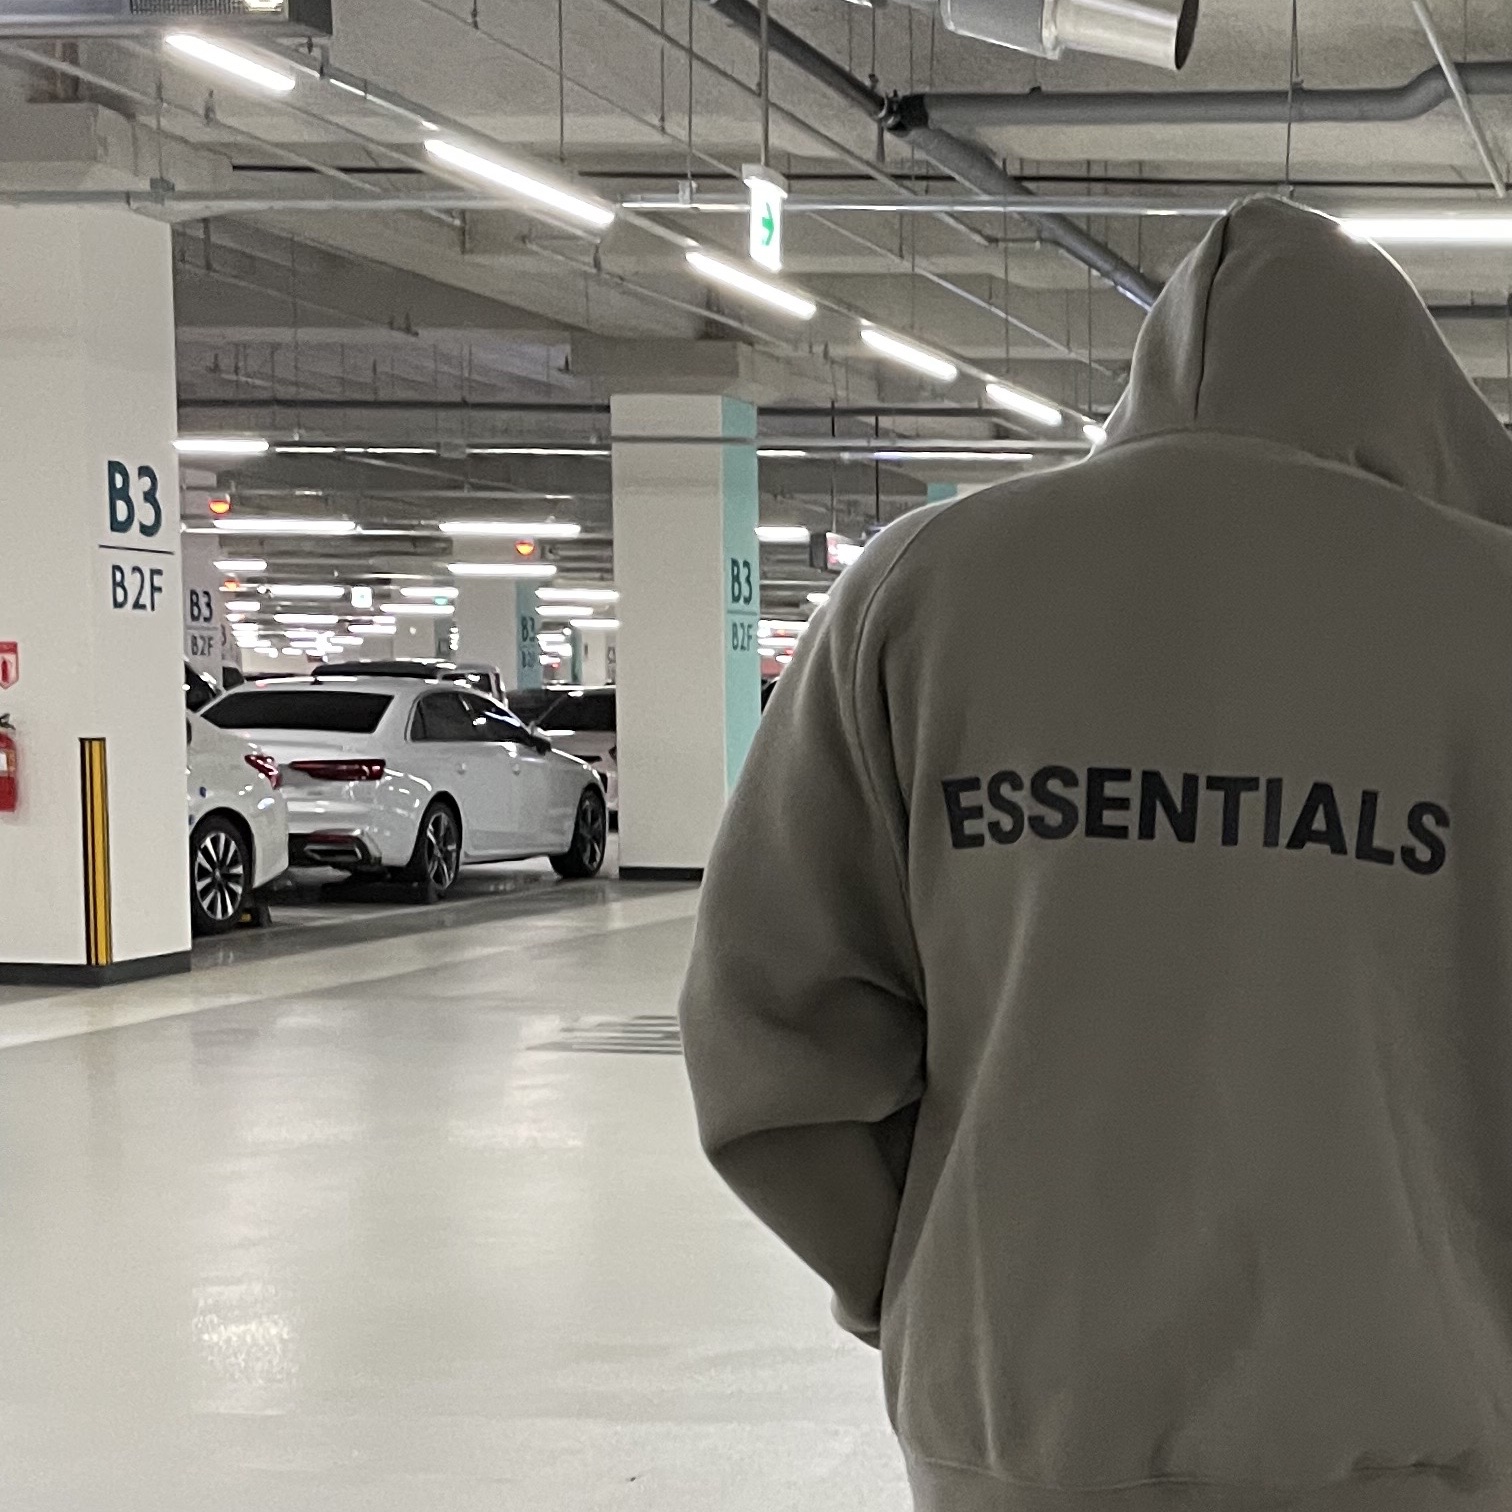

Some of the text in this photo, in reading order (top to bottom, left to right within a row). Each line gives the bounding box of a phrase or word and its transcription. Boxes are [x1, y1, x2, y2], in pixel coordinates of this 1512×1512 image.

[107, 460, 162, 538] B3
[111, 564, 164, 612] B2F
[189, 588, 213, 622] B3
[730, 557, 753, 606] B3
[190, 635, 214, 656] B2F
[731, 622, 753, 652] B2F
[941, 764, 1451, 876] ESSENTIALS
